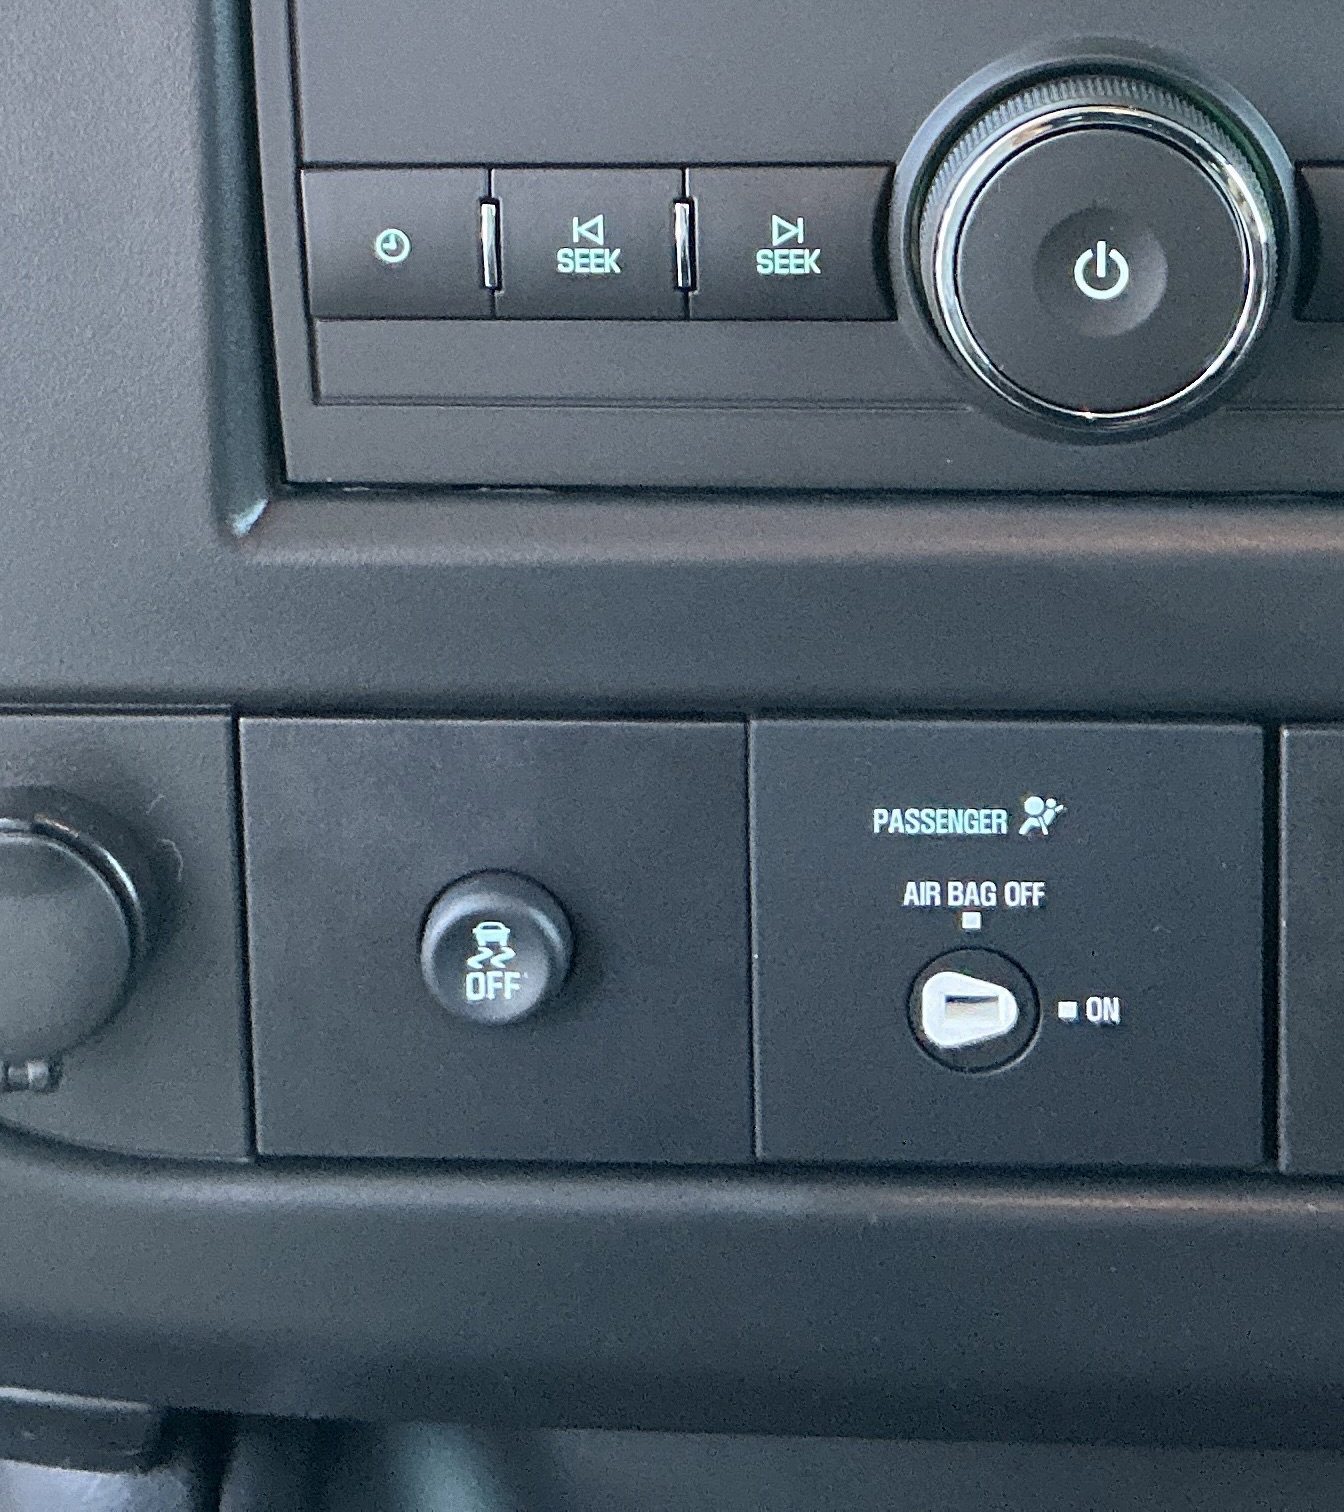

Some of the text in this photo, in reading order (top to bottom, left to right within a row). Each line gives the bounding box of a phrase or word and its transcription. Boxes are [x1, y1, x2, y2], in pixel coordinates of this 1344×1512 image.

[557, 248, 620, 273] SEEK
[756, 248, 820, 274] SEEK
[873, 808, 1007, 834] PASSENGER
[904, 881, 1044, 907] AIR BAG OFF
[465, 971, 520, 1001] OFF
[1086, 997, 1120, 1024] ON
